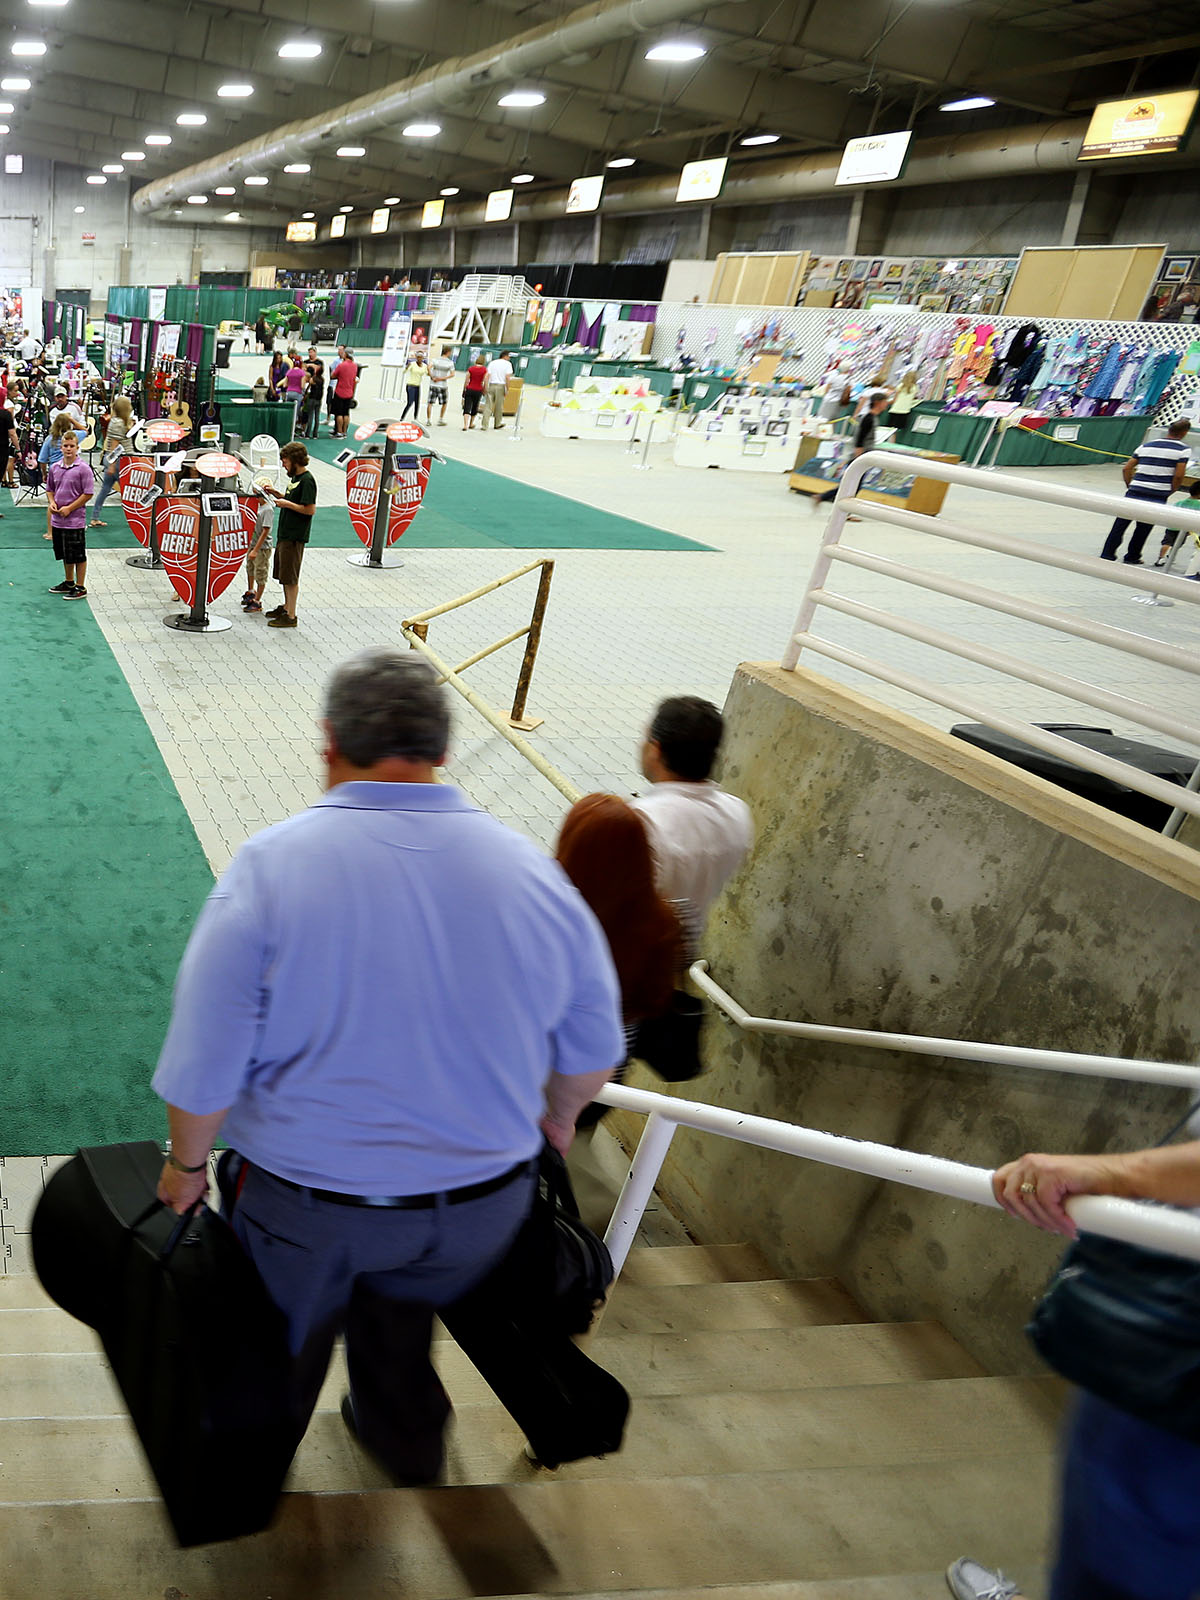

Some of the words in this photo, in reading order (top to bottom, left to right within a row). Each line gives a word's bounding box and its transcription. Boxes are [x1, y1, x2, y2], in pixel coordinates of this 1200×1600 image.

[129, 469, 152, 488] WIN
[355, 471, 377, 489] WIN
[348, 487, 376, 505] HERE!
[395, 485, 422, 505] HERE!
[169, 513, 196, 535] WIN
[216, 513, 243, 533] WIN
[160, 533, 196, 556] HERE!
[215, 530, 249, 553] HERE!
